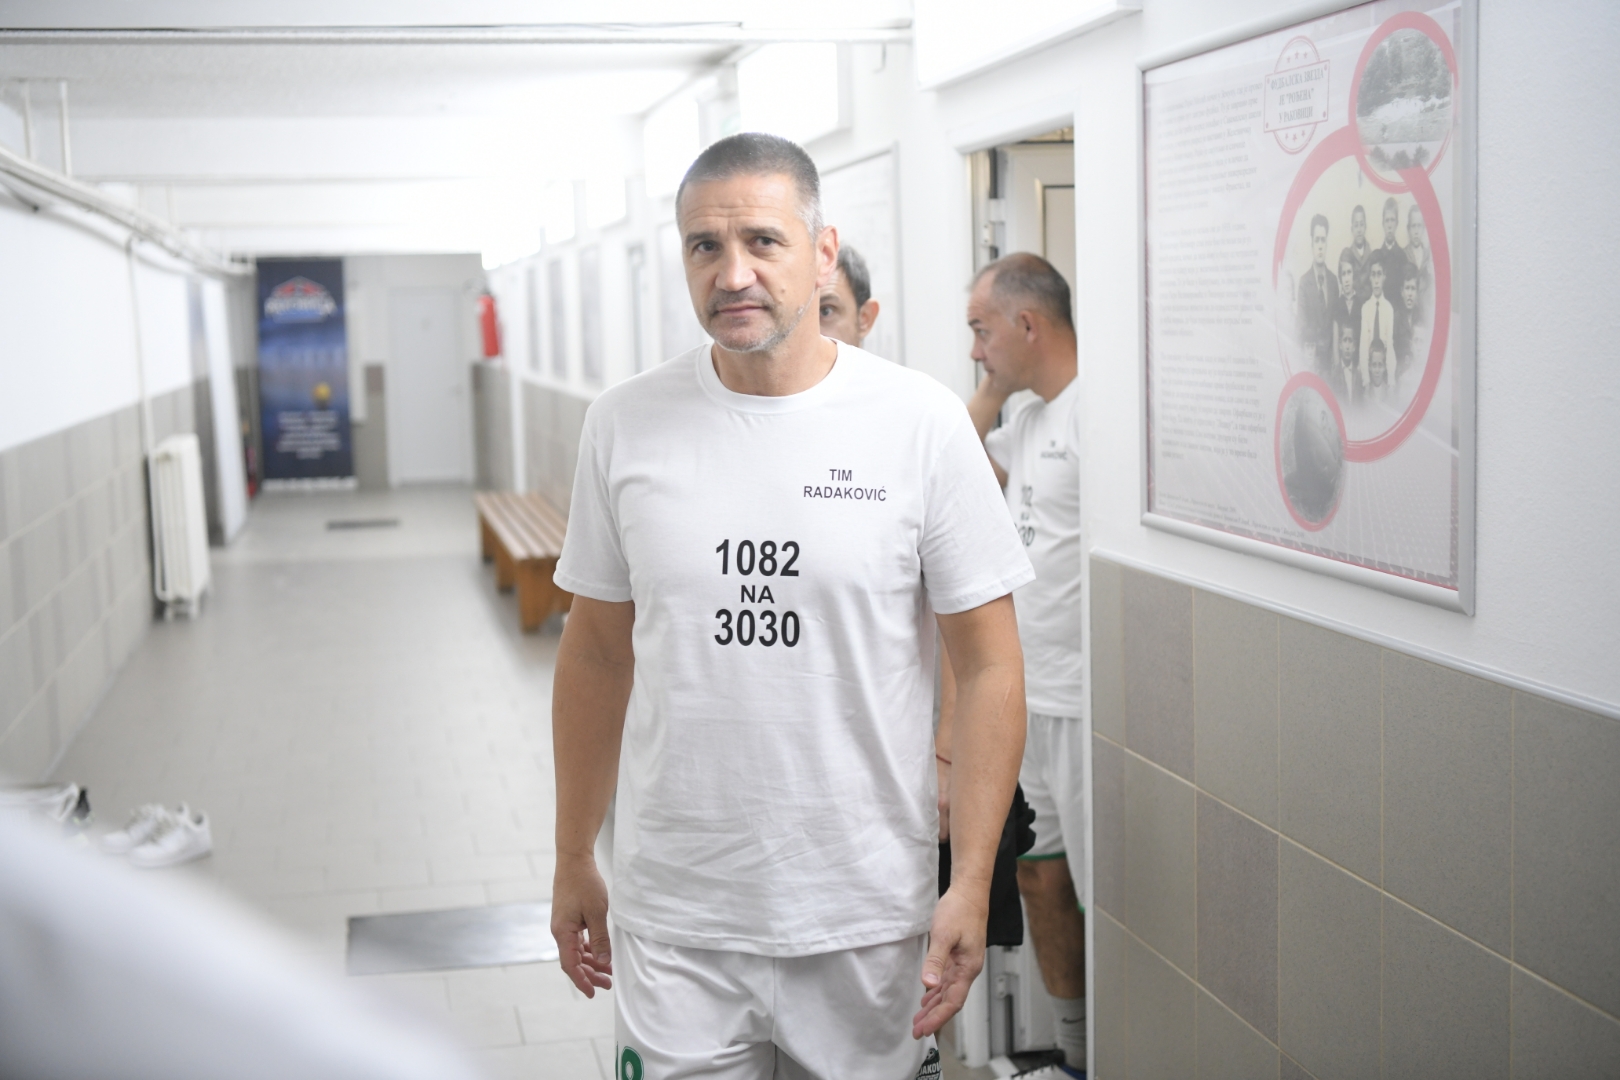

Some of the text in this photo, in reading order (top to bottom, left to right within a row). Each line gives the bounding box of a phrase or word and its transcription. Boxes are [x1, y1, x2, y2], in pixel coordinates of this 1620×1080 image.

[829, 469, 852, 482] TIM
[803, 486, 887, 502] RADAKOVIĆ
[715, 539, 800, 577] 1082
[740, 584, 776, 604] NA
[714, 608, 800, 648] 3030
